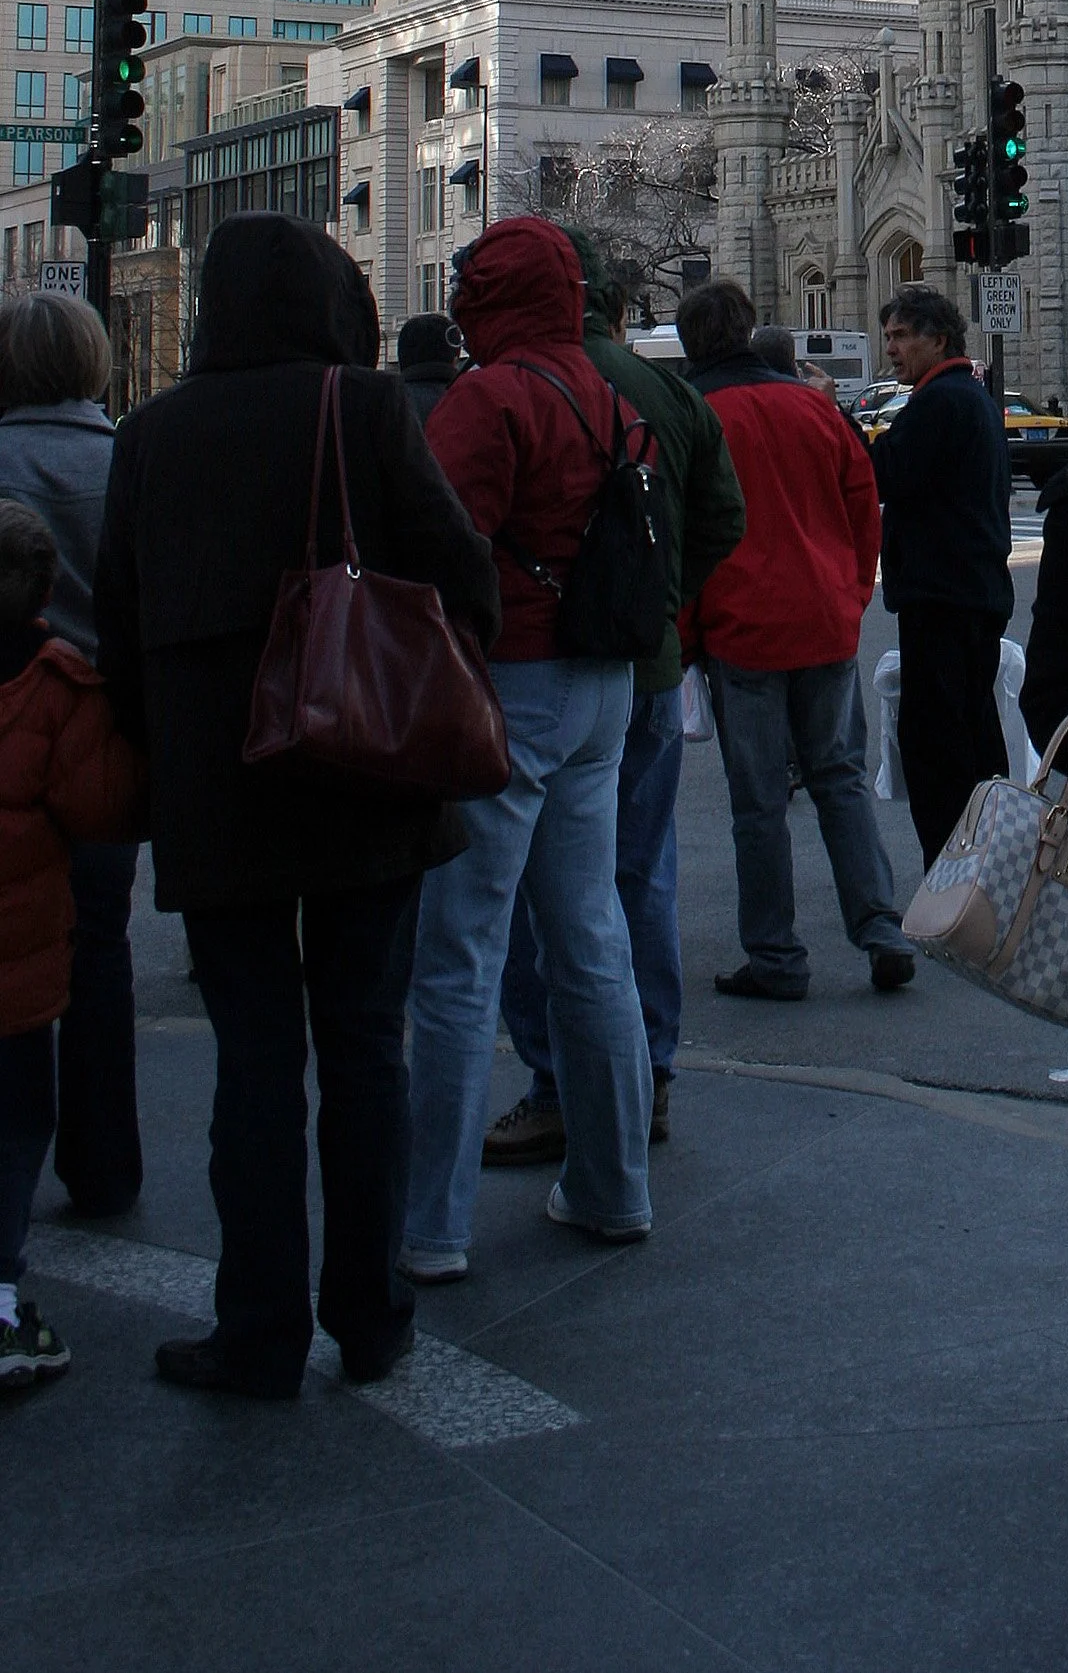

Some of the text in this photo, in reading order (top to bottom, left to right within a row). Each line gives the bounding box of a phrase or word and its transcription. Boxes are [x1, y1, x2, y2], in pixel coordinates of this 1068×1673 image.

[7, 127, 73, 141] PEARSON
[46, 266, 80, 280] ONE
[983, 277, 1018, 288] LEFT ON
[987, 290, 1015, 302] GREEN
[986, 304, 1016, 315] ARROW
[990, 317, 1012, 329] ONLY
